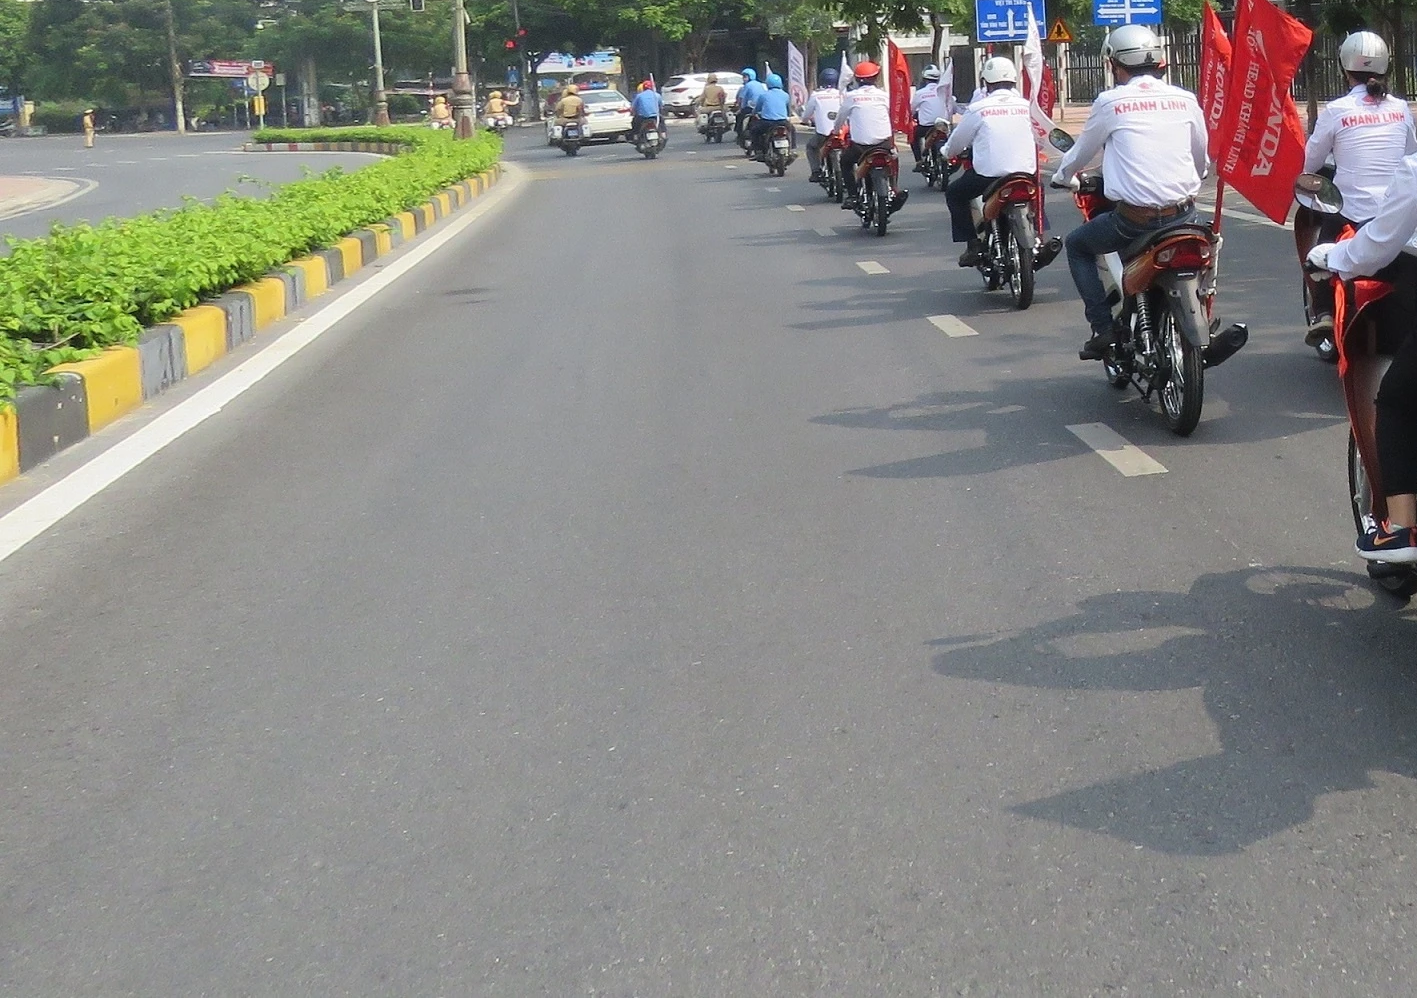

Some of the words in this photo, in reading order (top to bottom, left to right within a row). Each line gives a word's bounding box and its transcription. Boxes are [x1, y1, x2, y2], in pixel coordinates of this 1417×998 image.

[1244, 60, 1259, 99] HEAD
[1114, 98, 1157, 116] KHÁNH
[1161, 100, 1188, 112] LINH
[1234, 100, 1253, 145] KHÁNH
[1383, 112, 1405, 123] LINH
[1251, 83, 1284, 177] NDA
[1223, 145, 1241, 173] LINH
